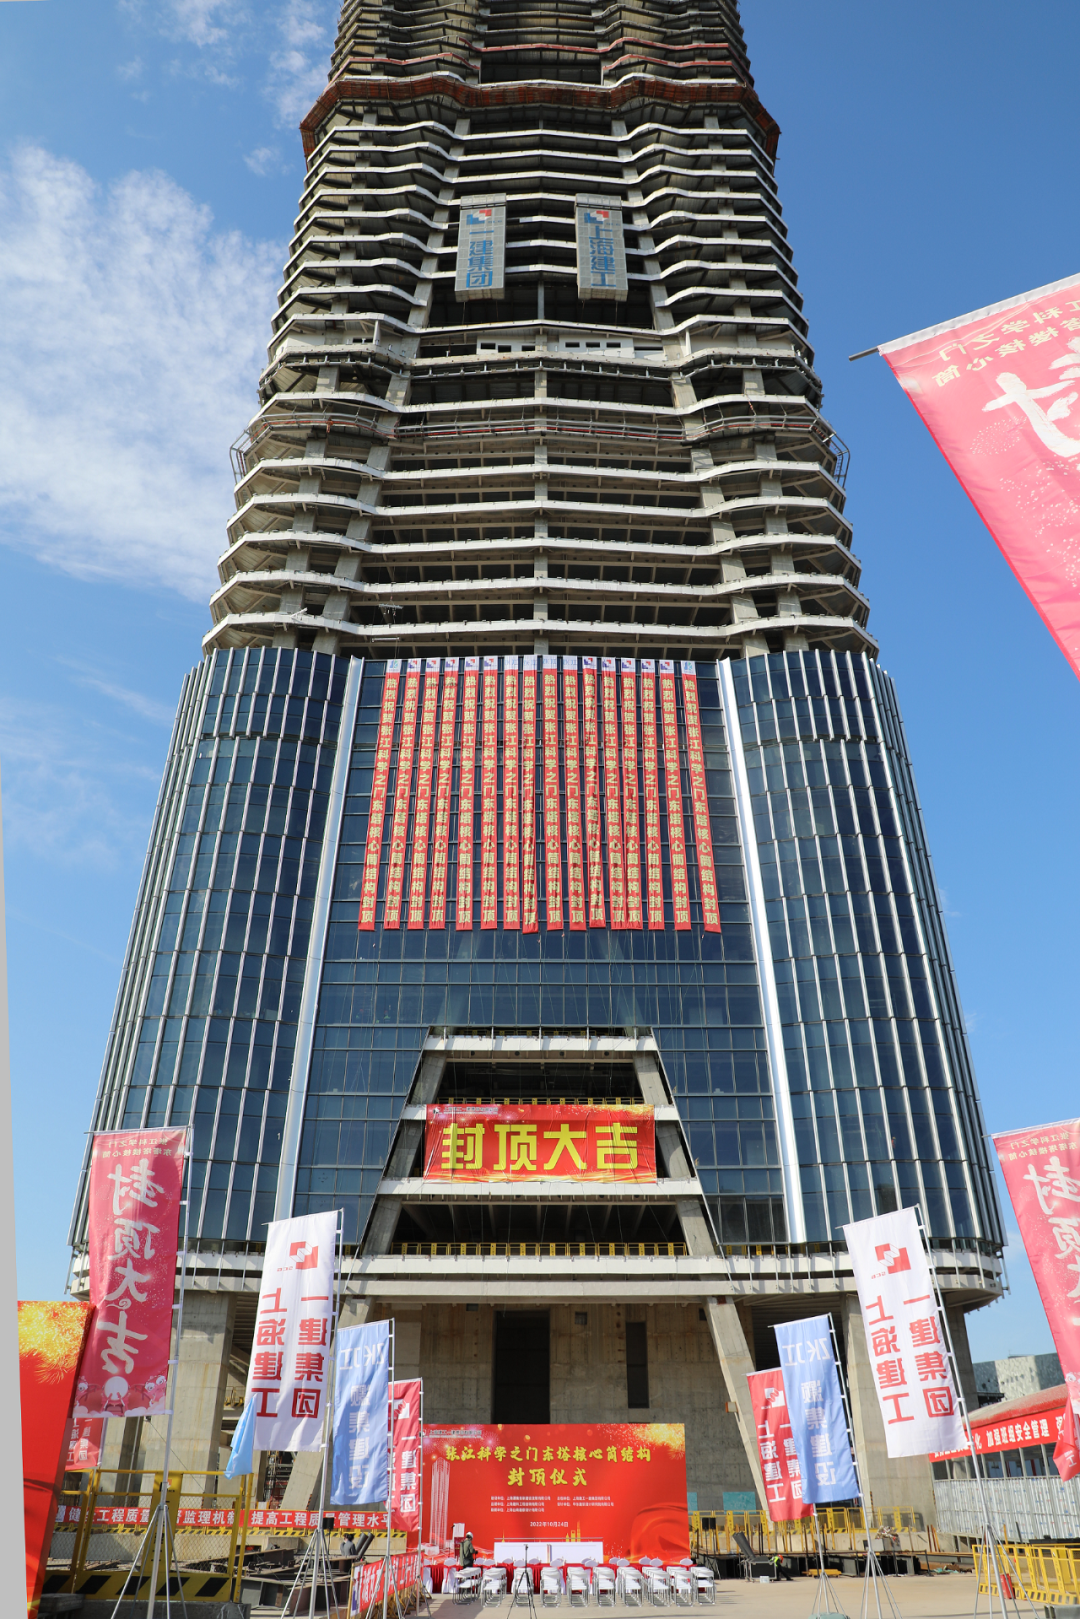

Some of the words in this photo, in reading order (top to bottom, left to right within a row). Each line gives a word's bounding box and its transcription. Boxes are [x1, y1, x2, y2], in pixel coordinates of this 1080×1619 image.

[466, 229, 494, 288] 一建集团
[589, 225, 616, 287] 上海建工
[441, 1122, 638, 1171] 封顶大吉
[986, 1420, 1050, 1448] 加强班组安全管理
[446, 1446, 651, 1463] 张江科学之门东塔核心筒结构
[507, 1467, 588, 1487] 封顶仪式
